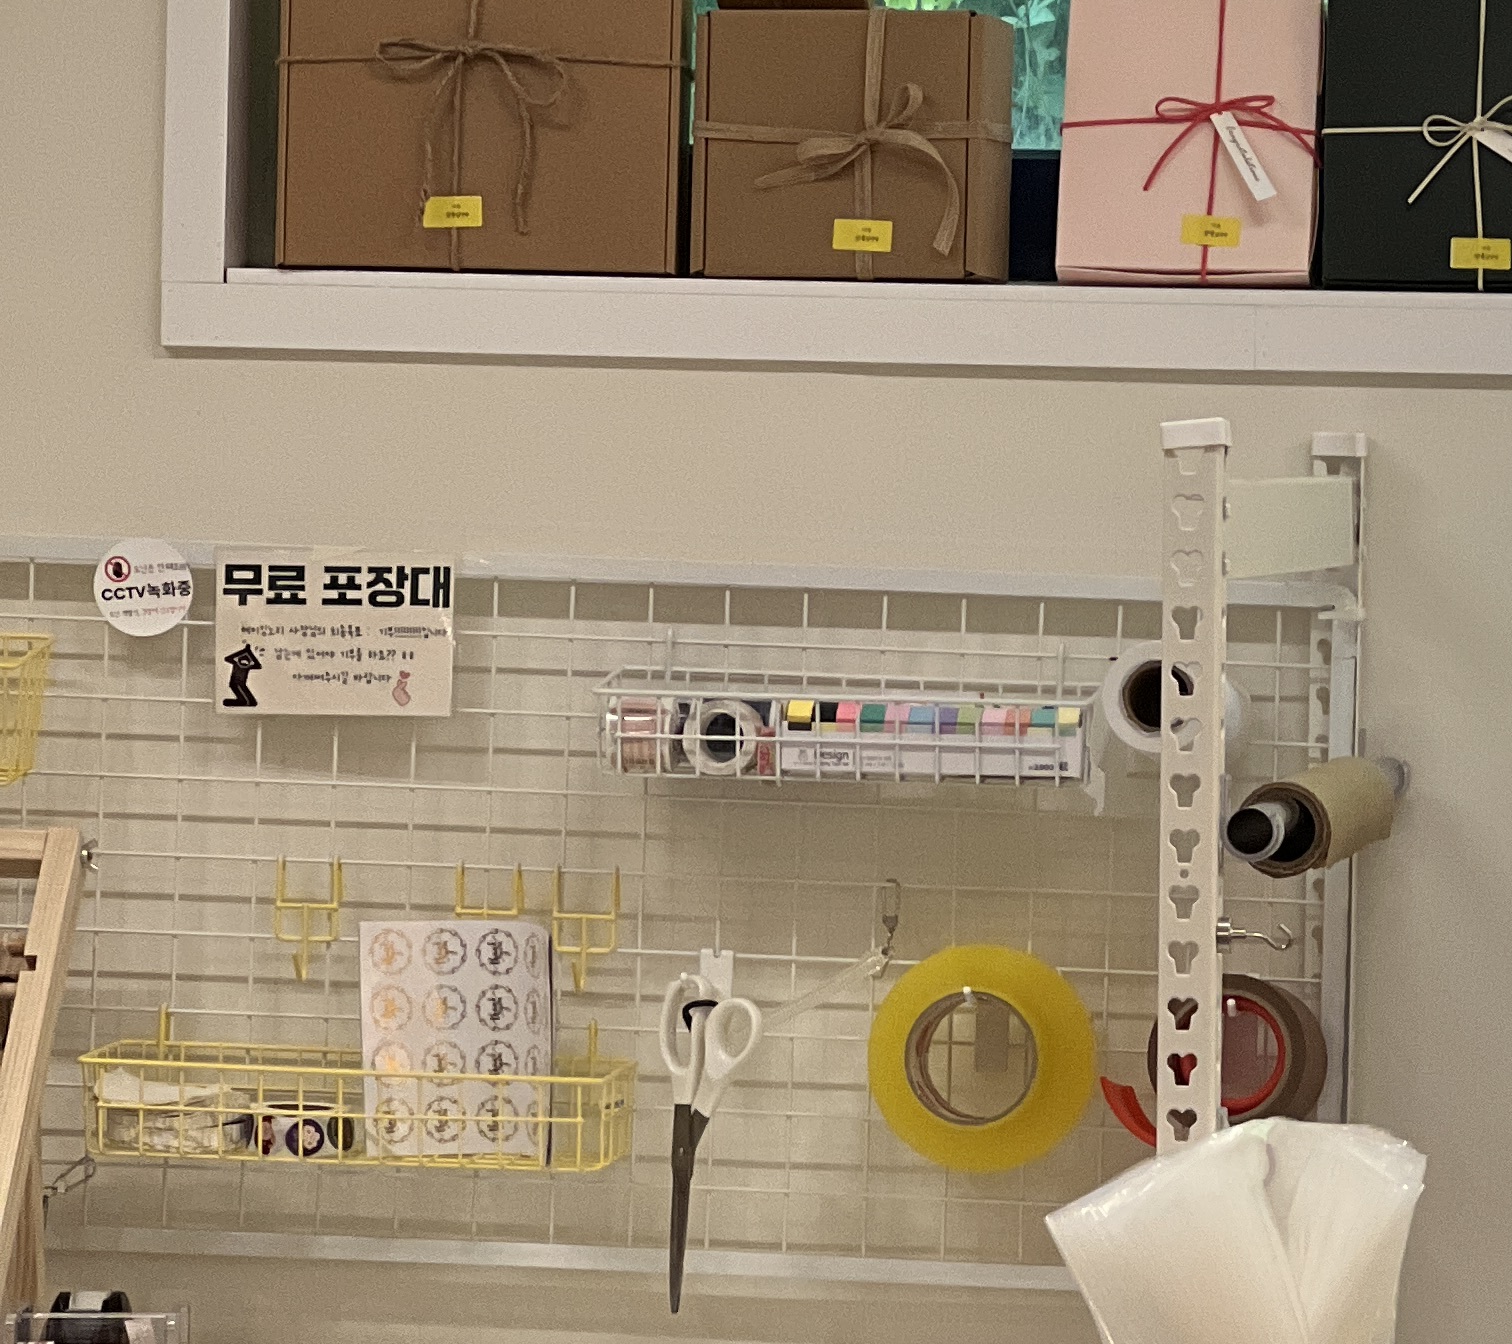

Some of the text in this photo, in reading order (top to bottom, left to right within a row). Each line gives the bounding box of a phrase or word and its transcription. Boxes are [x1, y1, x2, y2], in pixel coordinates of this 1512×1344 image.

[101, 580, 191, 602] CCTV녹화중
[223, 564, 451, 608] 무료 포장대
